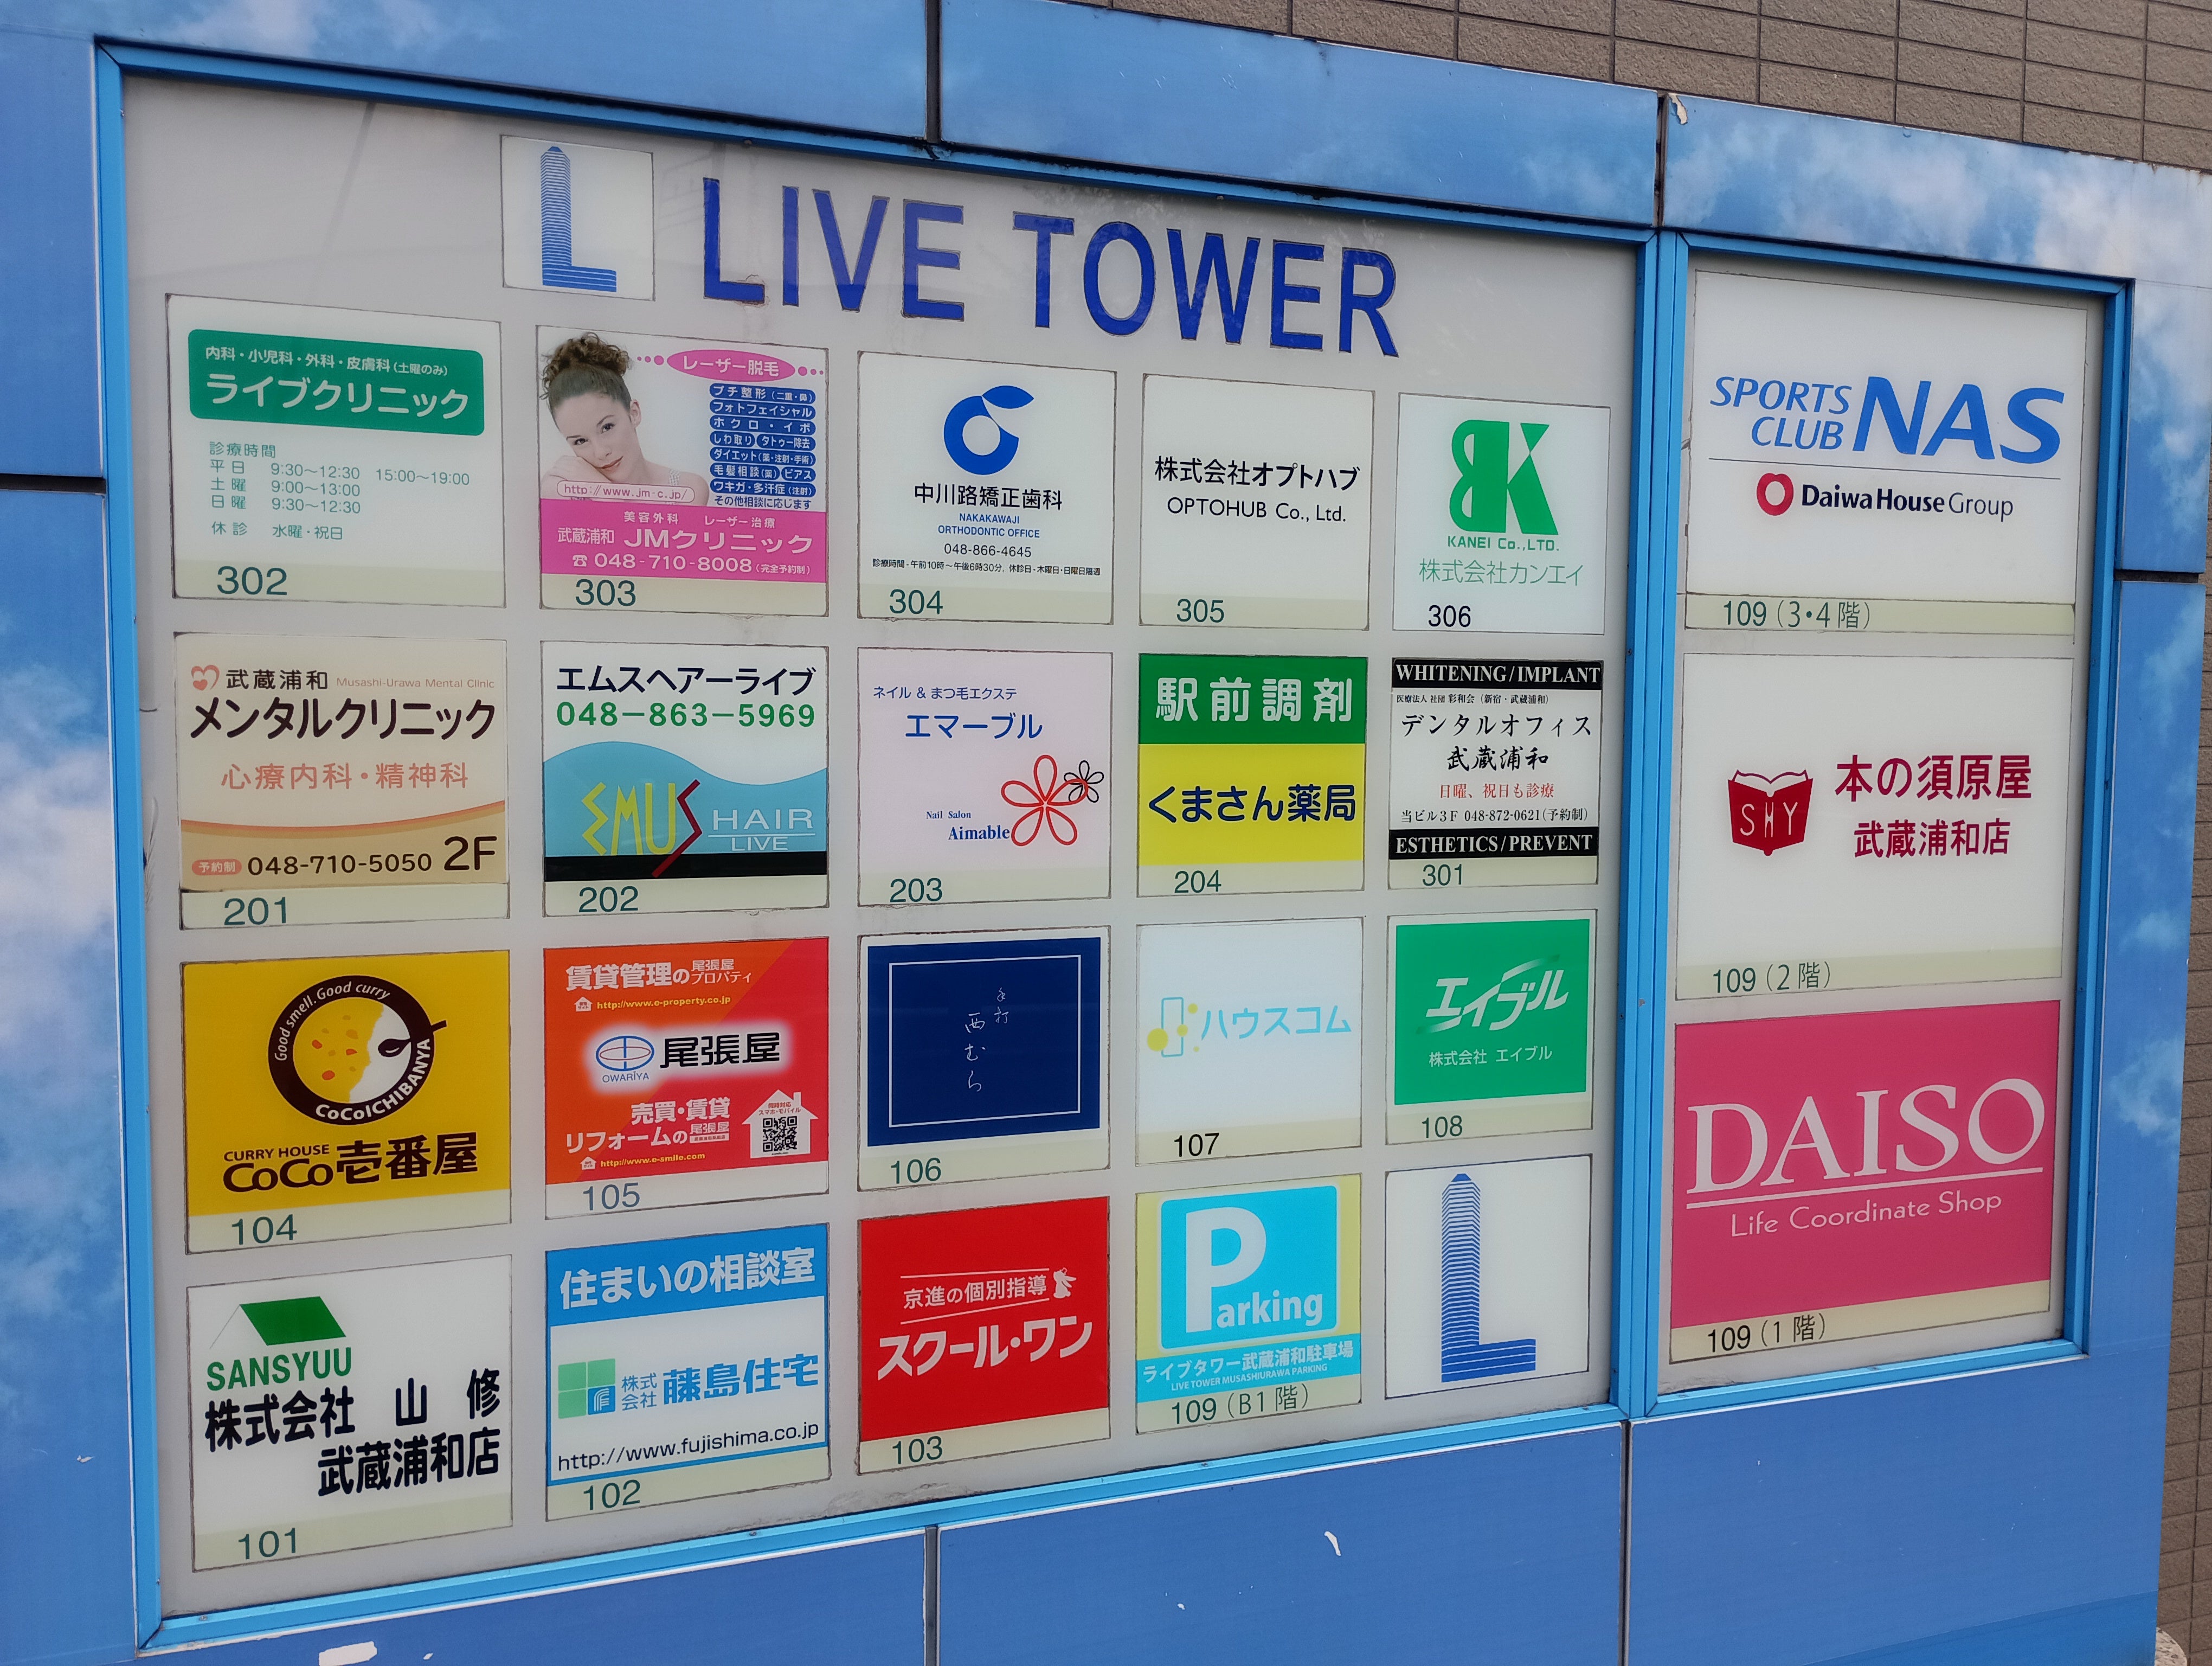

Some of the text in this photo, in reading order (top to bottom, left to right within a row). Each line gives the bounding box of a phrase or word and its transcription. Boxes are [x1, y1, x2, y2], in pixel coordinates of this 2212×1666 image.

[702, 177, 1399, 358] LIVE TOWER
[683, 355, 780, 376] レーザー脱毛
[207, 373, 468, 419] ライブクリニック
[1710, 376, 1852, 414] SPORTS
[713, 402, 812, 418] フォトフェイシャル
[1751, 376, 2065, 464] CLUB NAS
[209, 441, 276, 458] 診療時間
[714, 434, 811, 449] しわ取り タトゥー除去
[1154, 454, 1361, 491] 株式会社オプトハブ
[715, 496, 811, 509] その他相談に応じます
[915, 483, 1063, 511] 中川路矯正歯科
[1167, 497, 1267, 518] OPTOHUB
[1316, 504, 1347, 522] Ltd.
[1801, 484, 2014, 522] Daiwa House Group
[272, 524, 343, 540] 水曜・祝日
[623, 511, 776, 528] 美容外科 レーザー治療
[938, 526, 1040, 538] ORTHODONTIC OFFICE
[960, 514, 1020, 524] NAKAKAWAJI
[557, 528, 813, 554] 武蔵浦和 JMクリニック
[944, 543, 1032, 558] 048-866-4645
[1448, 536, 1491, 549] KANEI
[594, 554, 753, 573] 048-710-8008
[1419, 558, 1584, 586] 株式会社カンエイ
[217, 566, 287, 596] 302
[576, 579, 636, 606] 303
[889, 588, 943, 615] 304
[1176, 598, 1225, 624] 305
[1723, 601, 1767, 626] 109
[1427, 605, 1472, 627] 306
[226, 669, 328, 690] 武蔵浦和
[336, 677, 421, 689] Musashi-Urawa
[425, 678, 463, 688] Mental
[556, 665, 816, 696] エムスヘアーライブ
[873, 686, 1017, 700] ネイル & まつ毛エクステ
[1156, 676, 1352, 722] 駅前調剤
[190, 696, 495, 740] メンタルクリニック
[556, 702, 815, 728] 048-863-5969
[905, 712, 1043, 739] エマーブル
[1401, 714, 1591, 737] デンタルオフィス
[1447, 746, 1548, 771] 武蔵浦和
[221, 762, 468, 790] 心療内科・精神科
[1835, 754, 2033, 802] 本の須原屋
[1149, 784, 1355, 823] くまさん薬局
[1440, 783, 1554, 798] 日曜、祝日も診療
[712, 809, 813, 831] HAIR
[926, 810, 972, 819] Nail Salon
[1740, 802, 1799, 838] SHY
[731, 837, 789, 851] LIVE
[948, 825, 1010, 840] Aimable
[1854, 817, 2011, 858] 武蔵浦和店
[198, 836, 498, 876] 予約制 048-710-5050 2F
[1174, 870, 1221, 893] 204
[1422, 863, 1462, 886] 301
[578, 886, 639, 912] 202
[890, 877, 943, 902] 203
[224, 896, 287, 926] 201
[565, 959, 734, 991] 賃貸管理の 尾張屋
[691, 972, 751, 984] プロパティ
[1713, 967, 1756, 994] 109
[597, 996, 731, 1009] http://www.e-property.co.jp
[1422, 960, 1568, 1033] エイブル
[274, 1027, 291, 1061] Good
[316, 981, 352, 999] Good
[355, 982, 391, 1000] curry
[1201, 1005, 1351, 1040] ハウスコム
[660, 1032, 780, 1068] 尾張屋
[964, 1013, 986, 1092] 西むら
[1429, 1046, 1552, 1067] 株式会社 エイブル
[631, 1098, 730, 1125] 売買・賃貸
[565, 1122, 729, 1152] リフォームの 尾張屋
[1422, 1116, 1462, 1138] 108
[1687, 1078, 2044, 1194] DAISO
[223, 1144, 330, 1162] CURRY HOUSE
[1174, 1133, 1219, 1157] 107
[223, 1132, 478, 1193] CoCo壱番屋
[600, 1153, 705, 1167] http://www.e-smile.com
[891, 1157, 941, 1184] 106
[583, 1182, 640, 1211] 105
[1732, 1190, 2002, 1237] Life Coordinate Shop
[232, 1214, 298, 1245] 104
[560, 1246, 815, 1310] 住まいの相談室
[1186, 1207, 1322, 1333] Parking
[903, 1275, 1046, 1309] 京進の個別指導
[878, 1316, 1092, 1381] スクール・ワン
[1707, 1325, 1751, 1354] 109
[207, 1347, 352, 1391] SANSYUU
[1143, 1341, 1353, 1383] ライブタワー武蔵浦和駐車場
[621, 1354, 818, 1405] 株式 藤島住宅
[1171, 1364, 1328, 1391] LIVE TOWER MUSASHIURAWA PARKING
[621, 1392, 657, 1411] 会社
[1171, 1398, 1216, 1425] 109
[205, 1385, 355, 1453] 株式会社
[558, 1422, 819, 1471] http://www.fujishima.co.jp
[892, 1436, 943, 1465] 103
[318, 1426, 500, 1496] 武蔵浦和店
[583, 1479, 641, 1511] 102
[238, 1528, 297, 1560] 101
